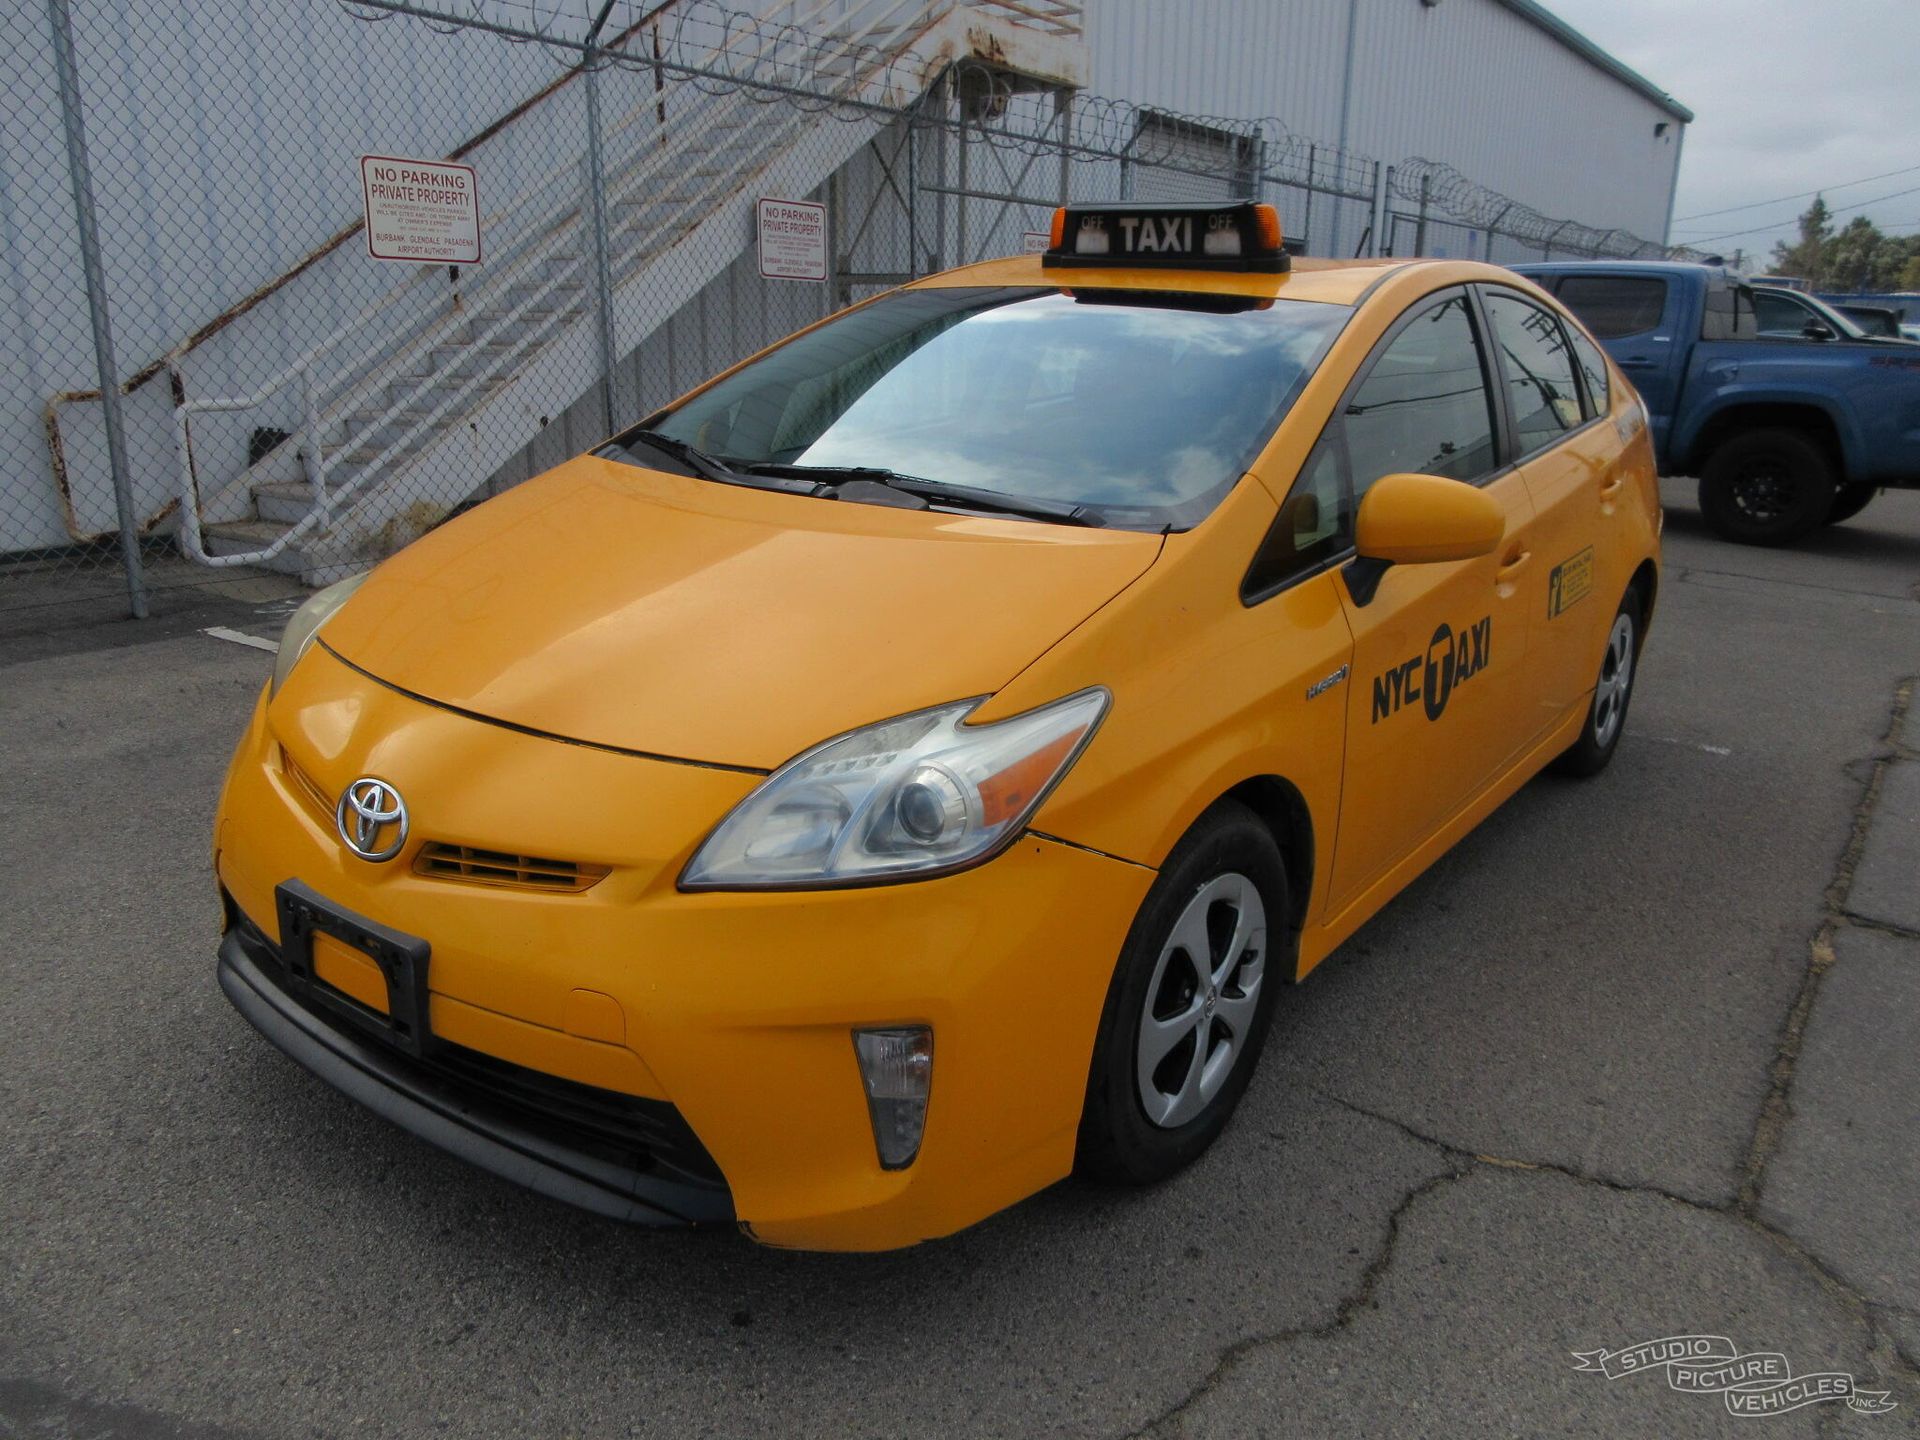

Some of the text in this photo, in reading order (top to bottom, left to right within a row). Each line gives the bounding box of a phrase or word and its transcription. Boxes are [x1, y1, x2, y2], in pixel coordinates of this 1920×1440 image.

[374, 167, 466, 189] NO PARKING
[371, 184, 470, 207] PRIVATE PROPERTY
[766, 207, 820, 223] NO PARKING
[1081, 215, 1105, 230] OFF
[1208, 214, 1234, 230] OFF
[763, 220, 821, 236] PRIVATE PROPERTY
[1119, 217, 1193, 253] TAXI
[398, 245, 456, 256] AIRPORT AUTHORITY
[1372, 615, 1491, 725] NYC TAXI
